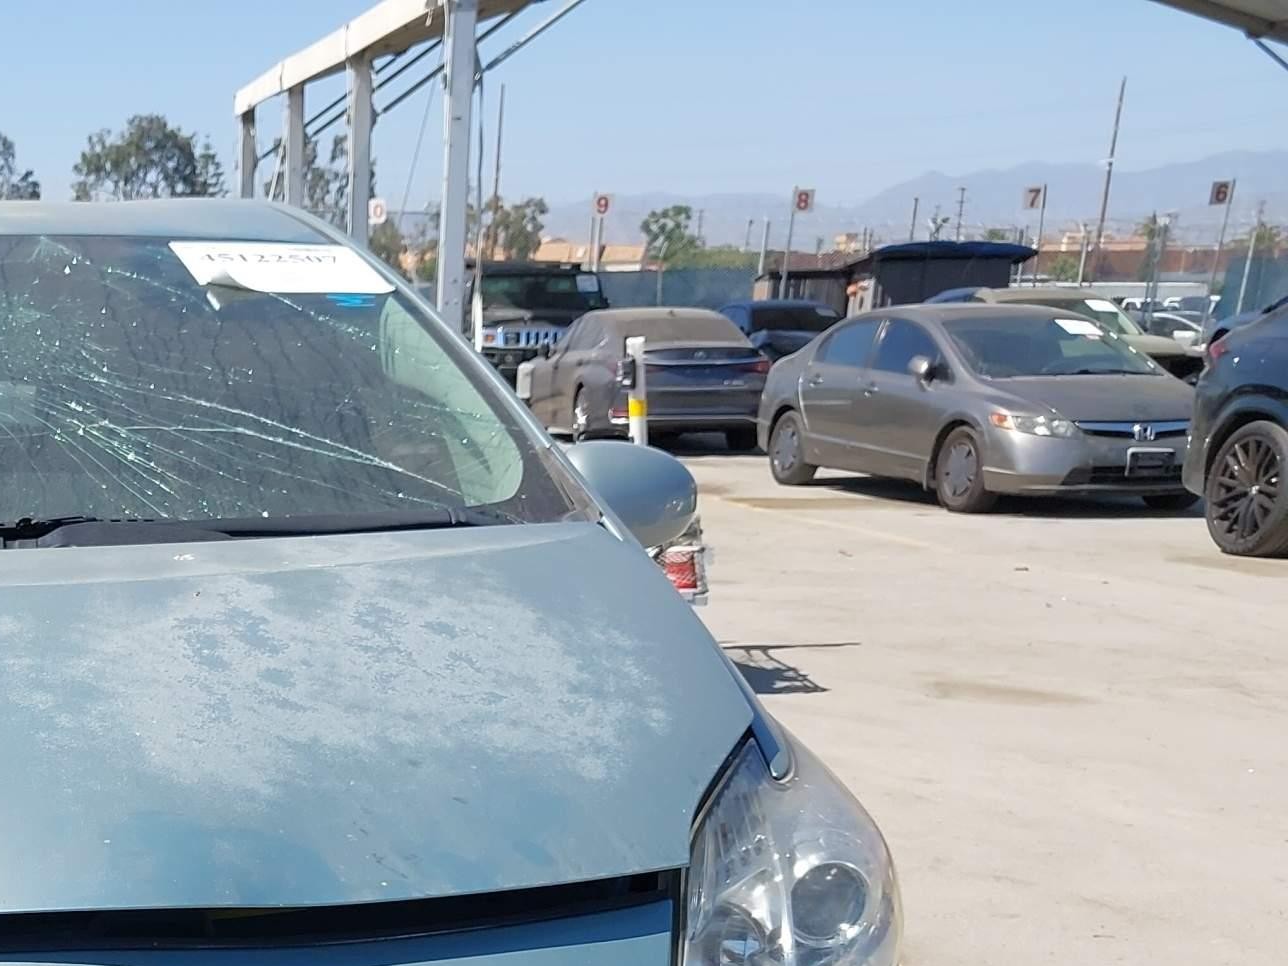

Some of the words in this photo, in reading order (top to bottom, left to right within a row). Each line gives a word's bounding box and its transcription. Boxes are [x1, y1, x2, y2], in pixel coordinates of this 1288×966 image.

[796, 191, 809, 211] 8
[1028, 188, 1041, 209] 7
[1215, 182, 1229, 203] 6
[596, 195, 609, 215] 9
